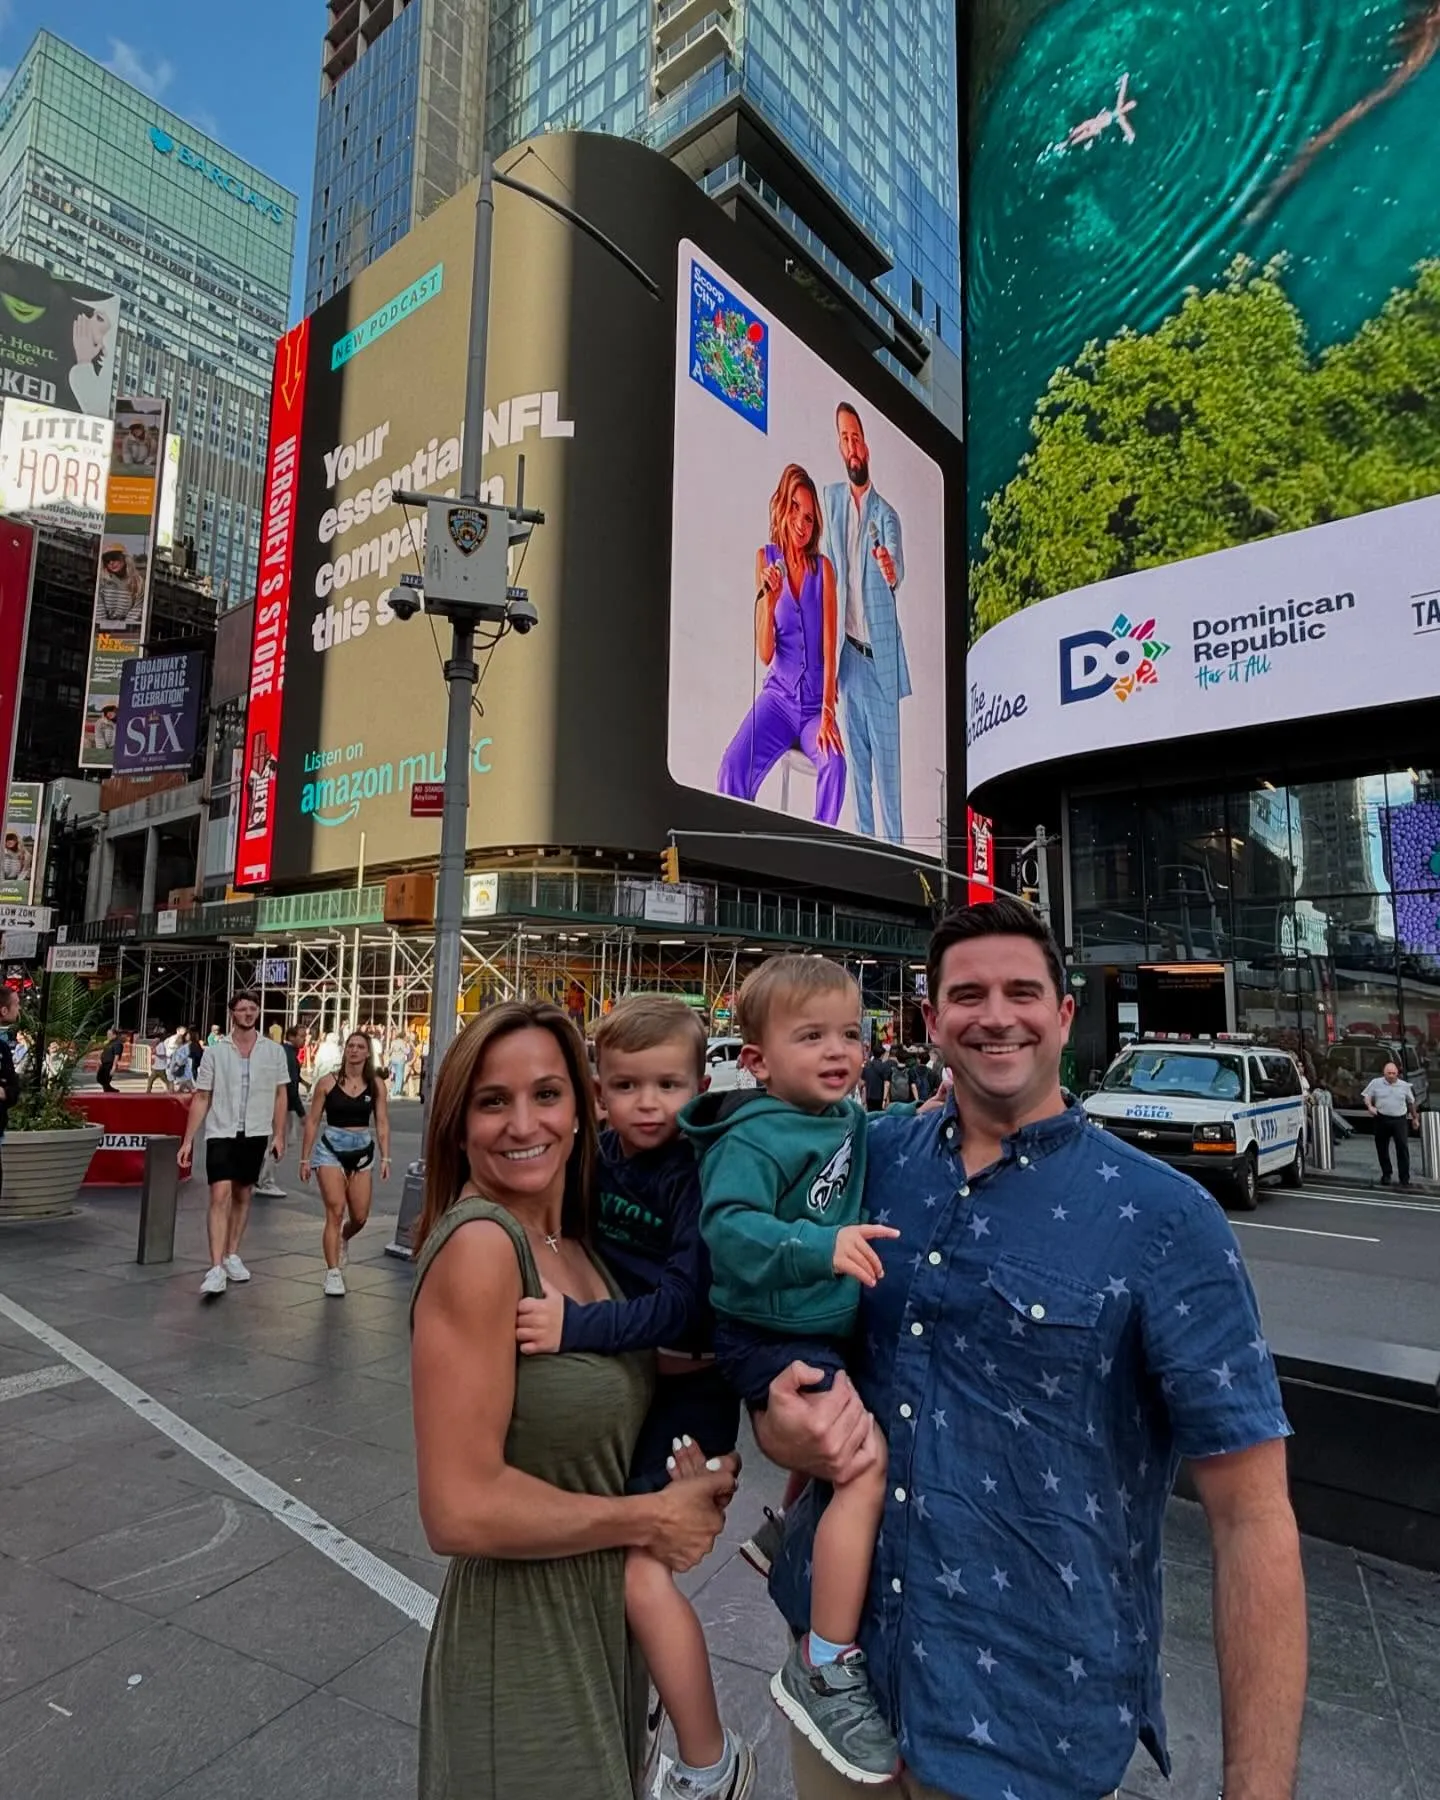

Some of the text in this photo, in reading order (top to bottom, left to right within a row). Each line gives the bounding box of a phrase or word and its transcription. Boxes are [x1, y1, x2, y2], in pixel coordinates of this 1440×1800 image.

[176, 146, 284, 224] BARCLAYS
[693, 267, 725, 303] Scoop
[693, 283, 716, 311] City
[335, 272, 438, 361] NEW PODCAST
[11, 336, 58, 361] Heart.
[0, 366, 57, 404] KED
[21, 417, 105, 443] LITTLE
[482, 391, 576, 457] NFL
[323, 421, 390, 489] Your
[17, 447, 101, 509] HORR
[261, 434, 298, 597] HERSHEY'S
[311, 597, 371, 653] this
[1192, 591, 1356, 641] Dominican
[250, 602, 280, 703] STORE
[1194, 621, 1327, 663] Republic
[135, 655, 188, 675] BROADWAY'S
[1195, 665, 1225, 691] Has
[969, 681, 986, 718] The
[301, 737, 493, 815] amazon muc
[304, 742, 363, 773] Listen on
[425, 785, 444, 793] STAND
[18, 909, 37, 918] ZONE
[1125, 1108, 1174, 1120] POLICE
